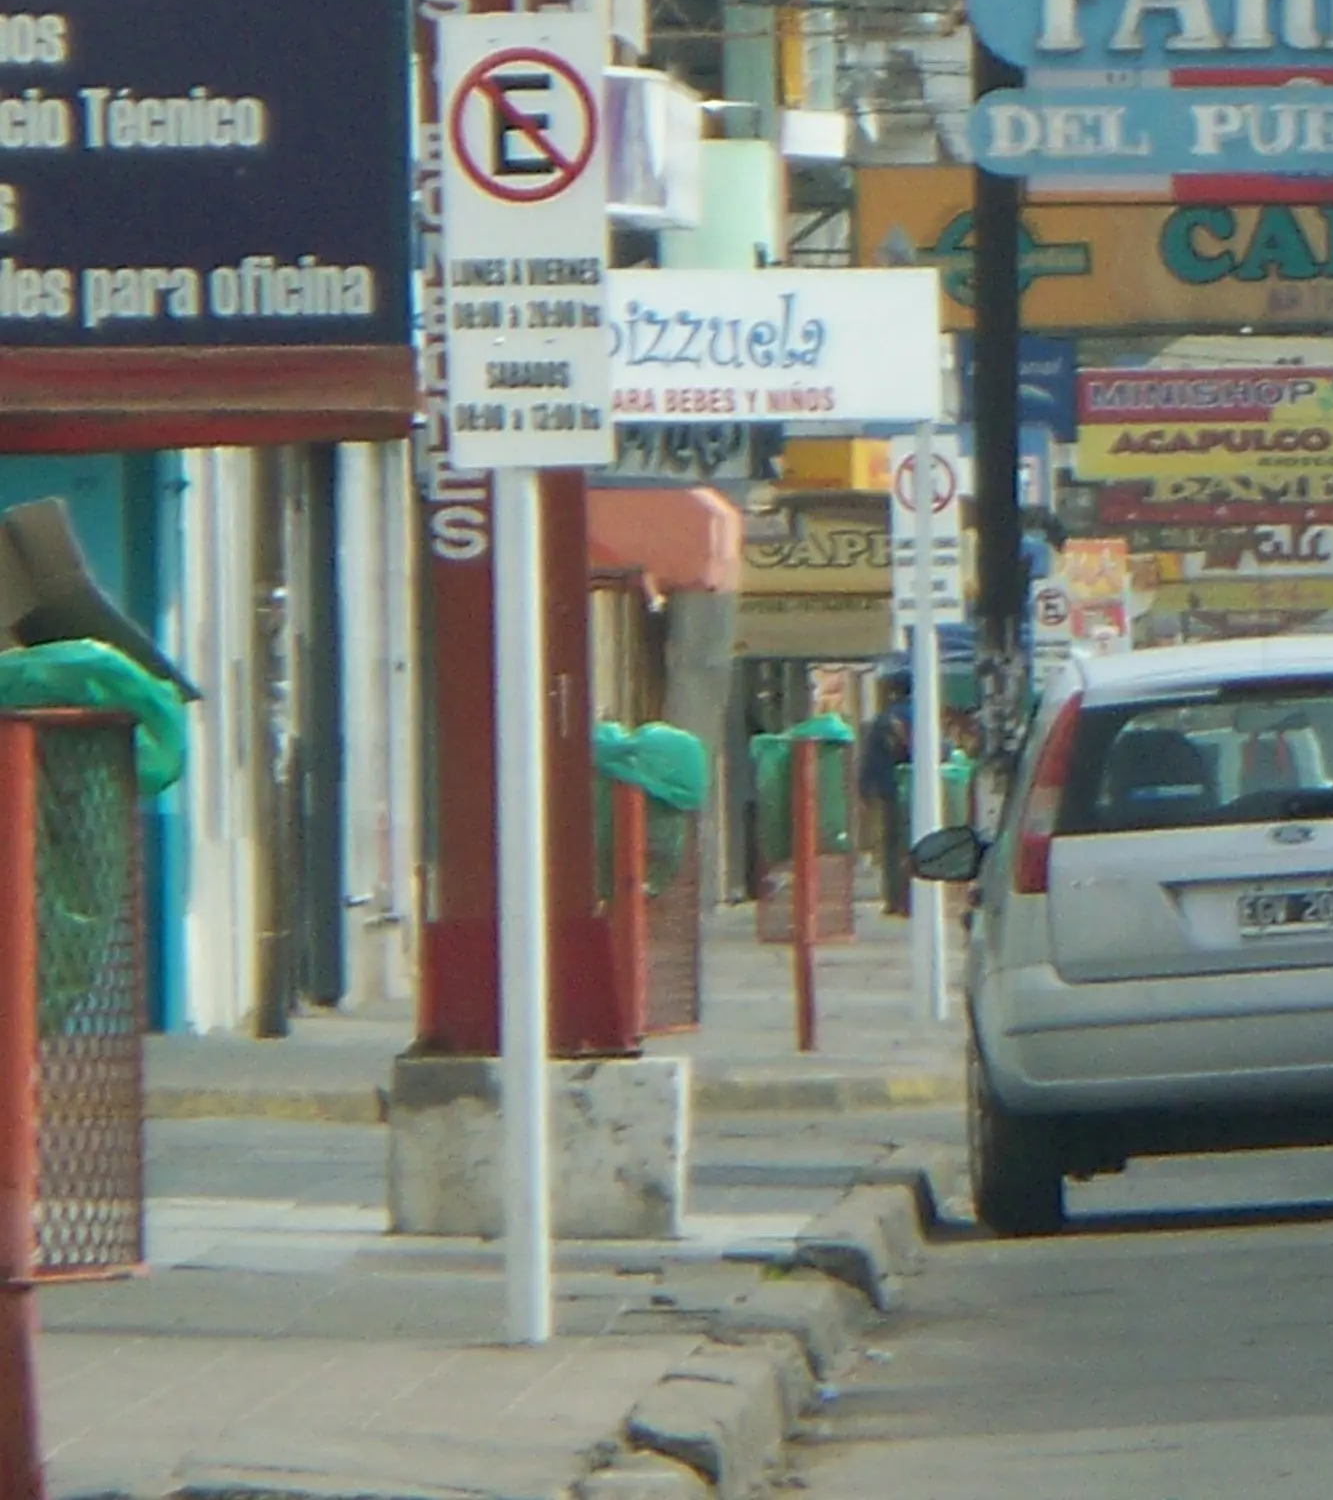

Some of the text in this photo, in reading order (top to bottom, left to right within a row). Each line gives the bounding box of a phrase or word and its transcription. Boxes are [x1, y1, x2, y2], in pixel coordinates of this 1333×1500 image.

[78, 87, 267, 149] Técnico
[987, 100, 1151, 161] DEL
[82, 267, 200, 328] para
[209, 256, 374, 317] oficina
[613, 382, 836, 414] ARA BEBES Y NIÑOS
[1090, 379, 1317, 410] MINISHOP
